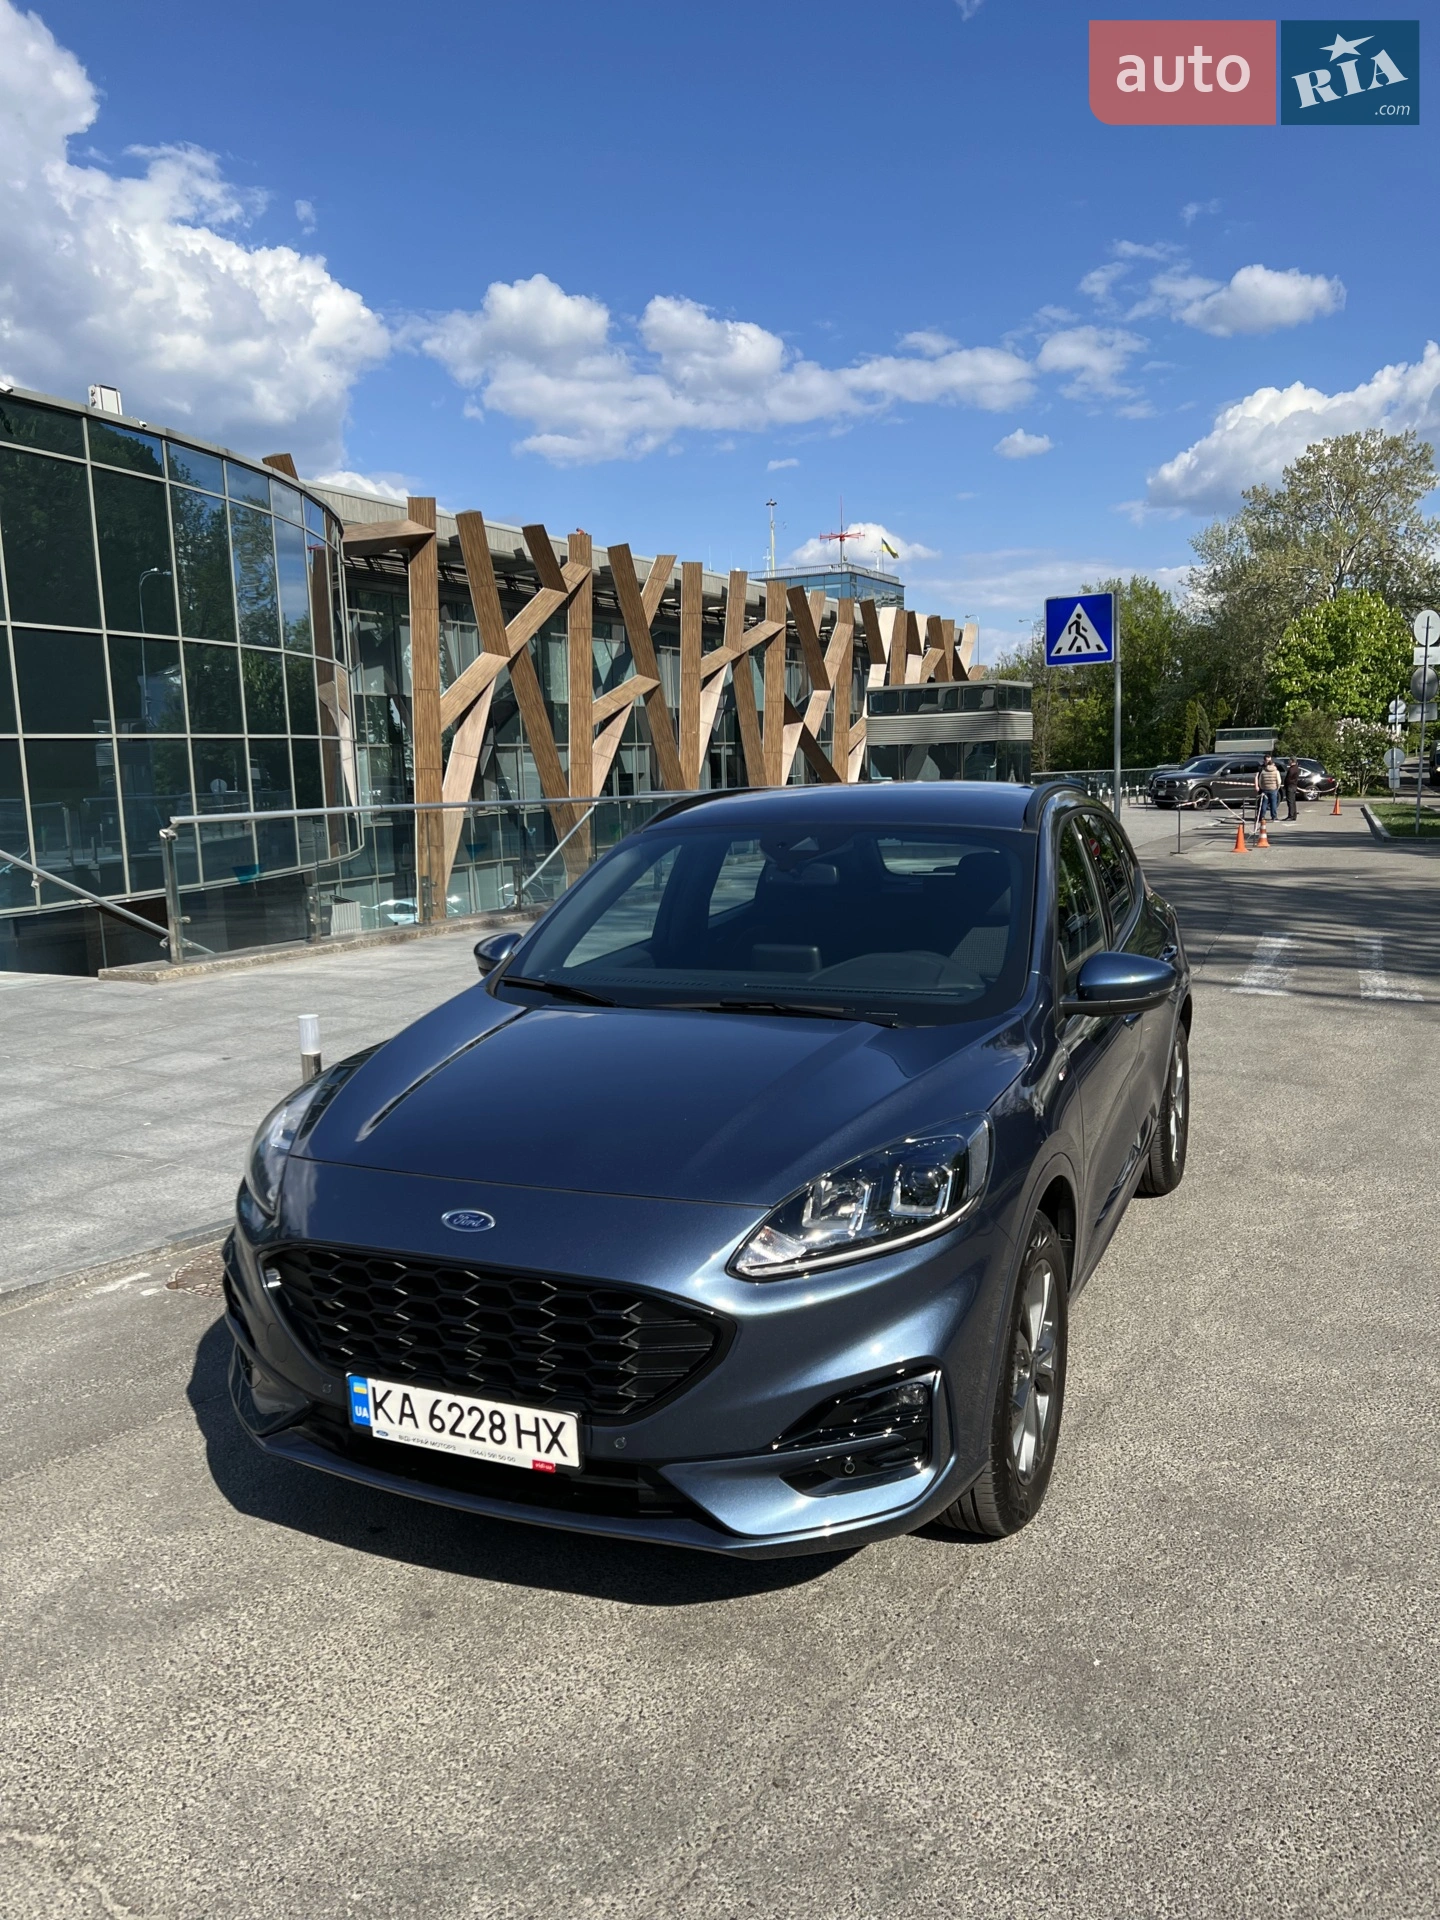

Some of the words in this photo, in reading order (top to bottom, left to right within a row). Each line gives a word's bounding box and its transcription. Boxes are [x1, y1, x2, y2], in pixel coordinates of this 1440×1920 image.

[453, 1213, 485, 1227] Ford
[354, 1405, 370, 1419] UA
[371, 1386, 419, 1429] KA
[428, 1399, 507, 1446] 6228
[515, 1413, 569, 1458] HX
